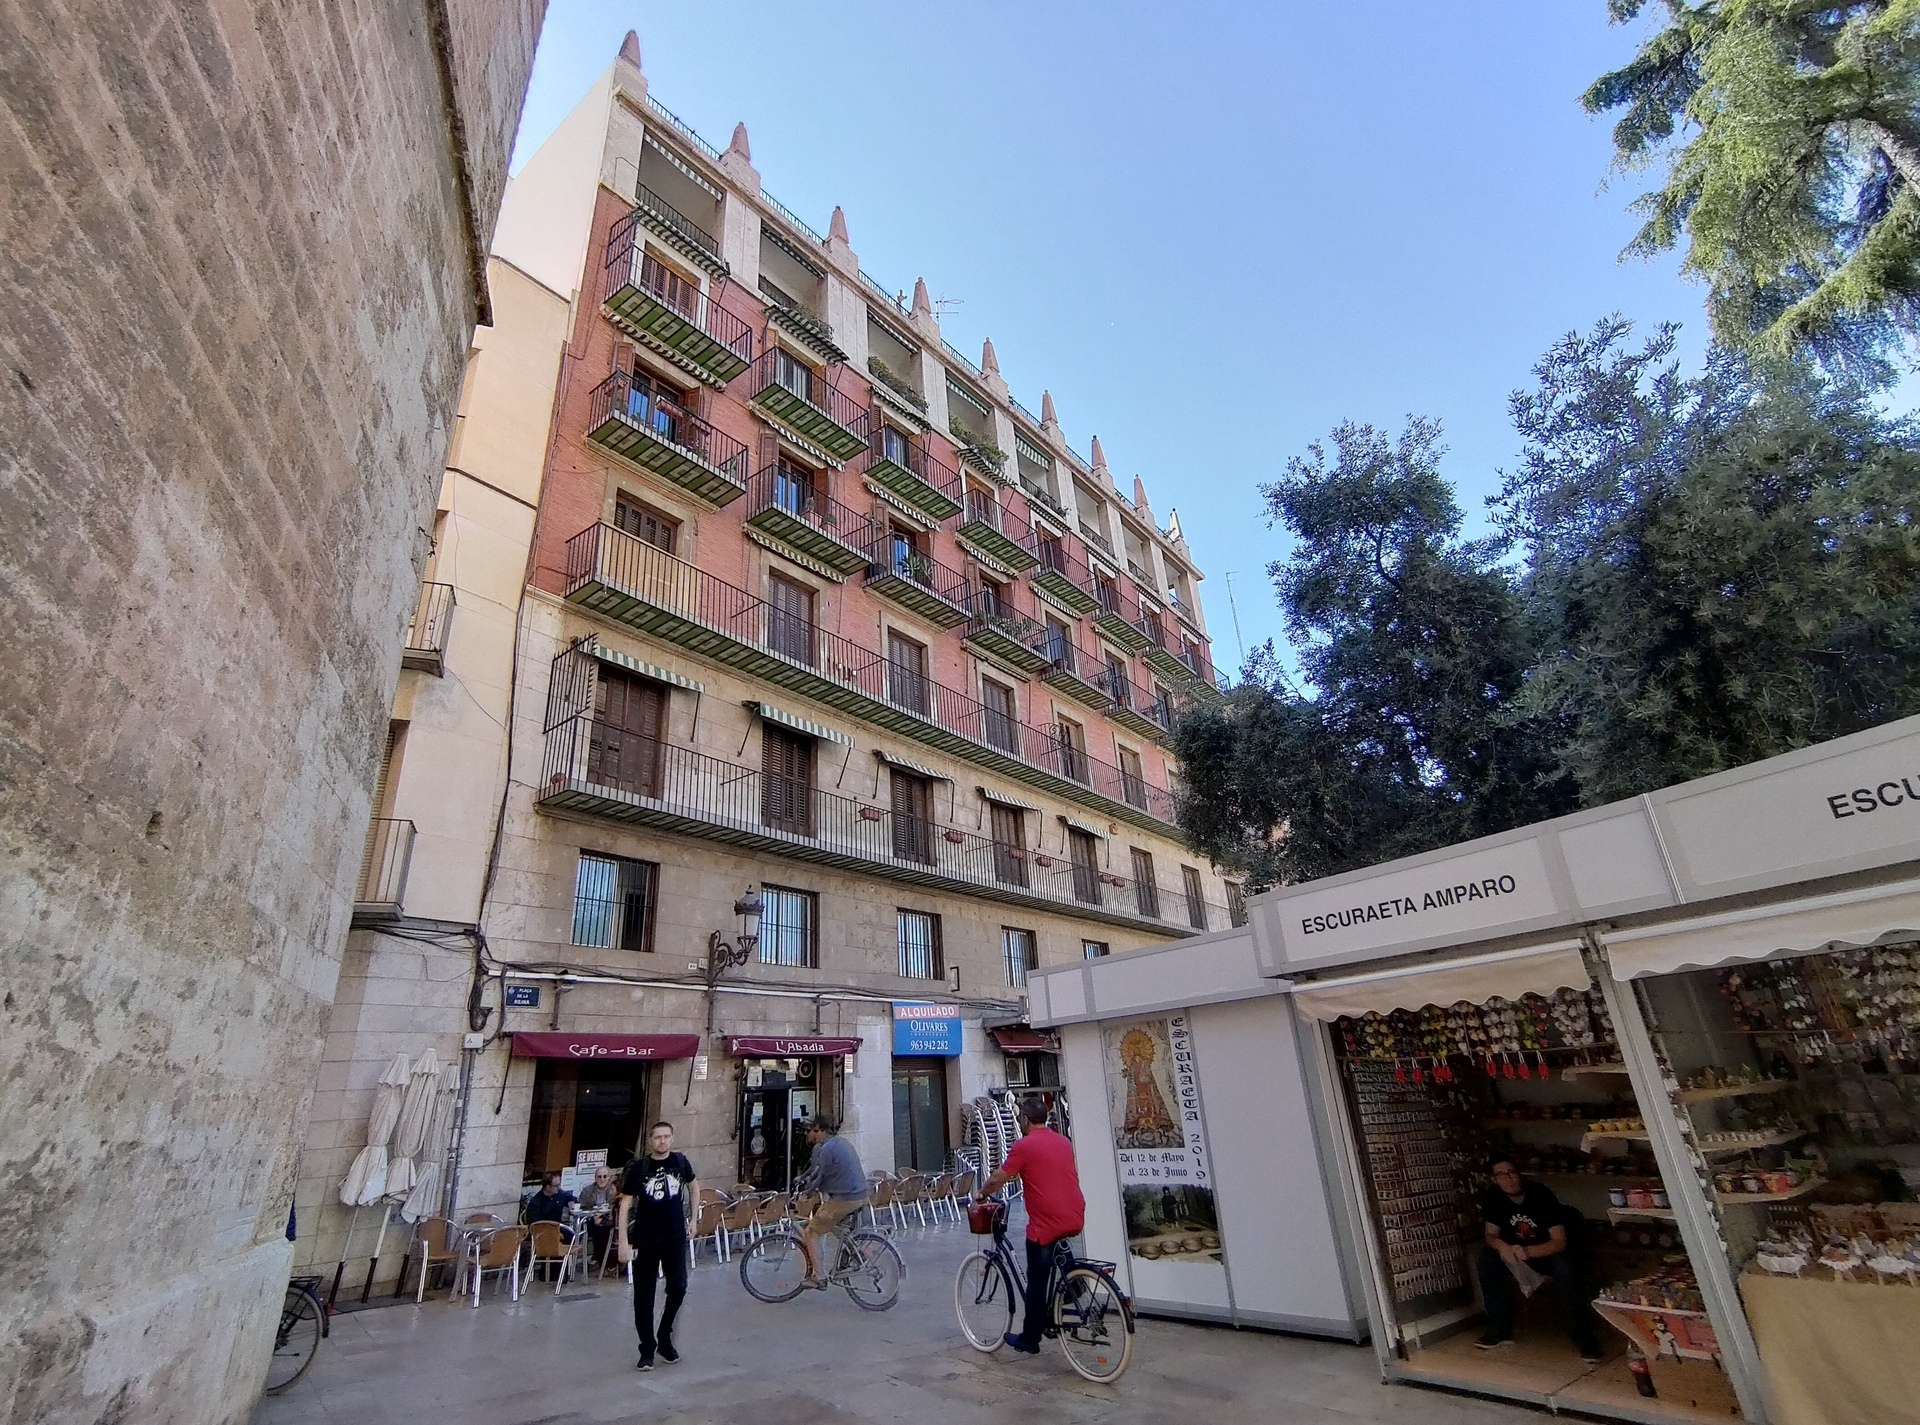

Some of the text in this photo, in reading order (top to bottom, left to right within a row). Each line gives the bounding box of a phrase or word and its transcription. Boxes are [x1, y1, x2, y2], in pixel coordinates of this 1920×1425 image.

[1302, 875, 1516, 934] ESCURAETA AMPARO
[901, 1006, 954, 1017] ALQUILADO
[910, 1020, 948, 1032] OLIVARES
[1171, 1017, 1206, 1180] ESCURAETA 2019
[578, 1151, 606, 1163] SE VENDE
[1119, 1153, 1133, 1163] Del
[1137, 1153, 1146, 1163] 12
[1148, 1153, 1157, 1163] de
[1127, 1167, 1135, 1177] al
[1138, 1167, 1149, 1177] 23
[1152, 1167, 1160, 1177] de
